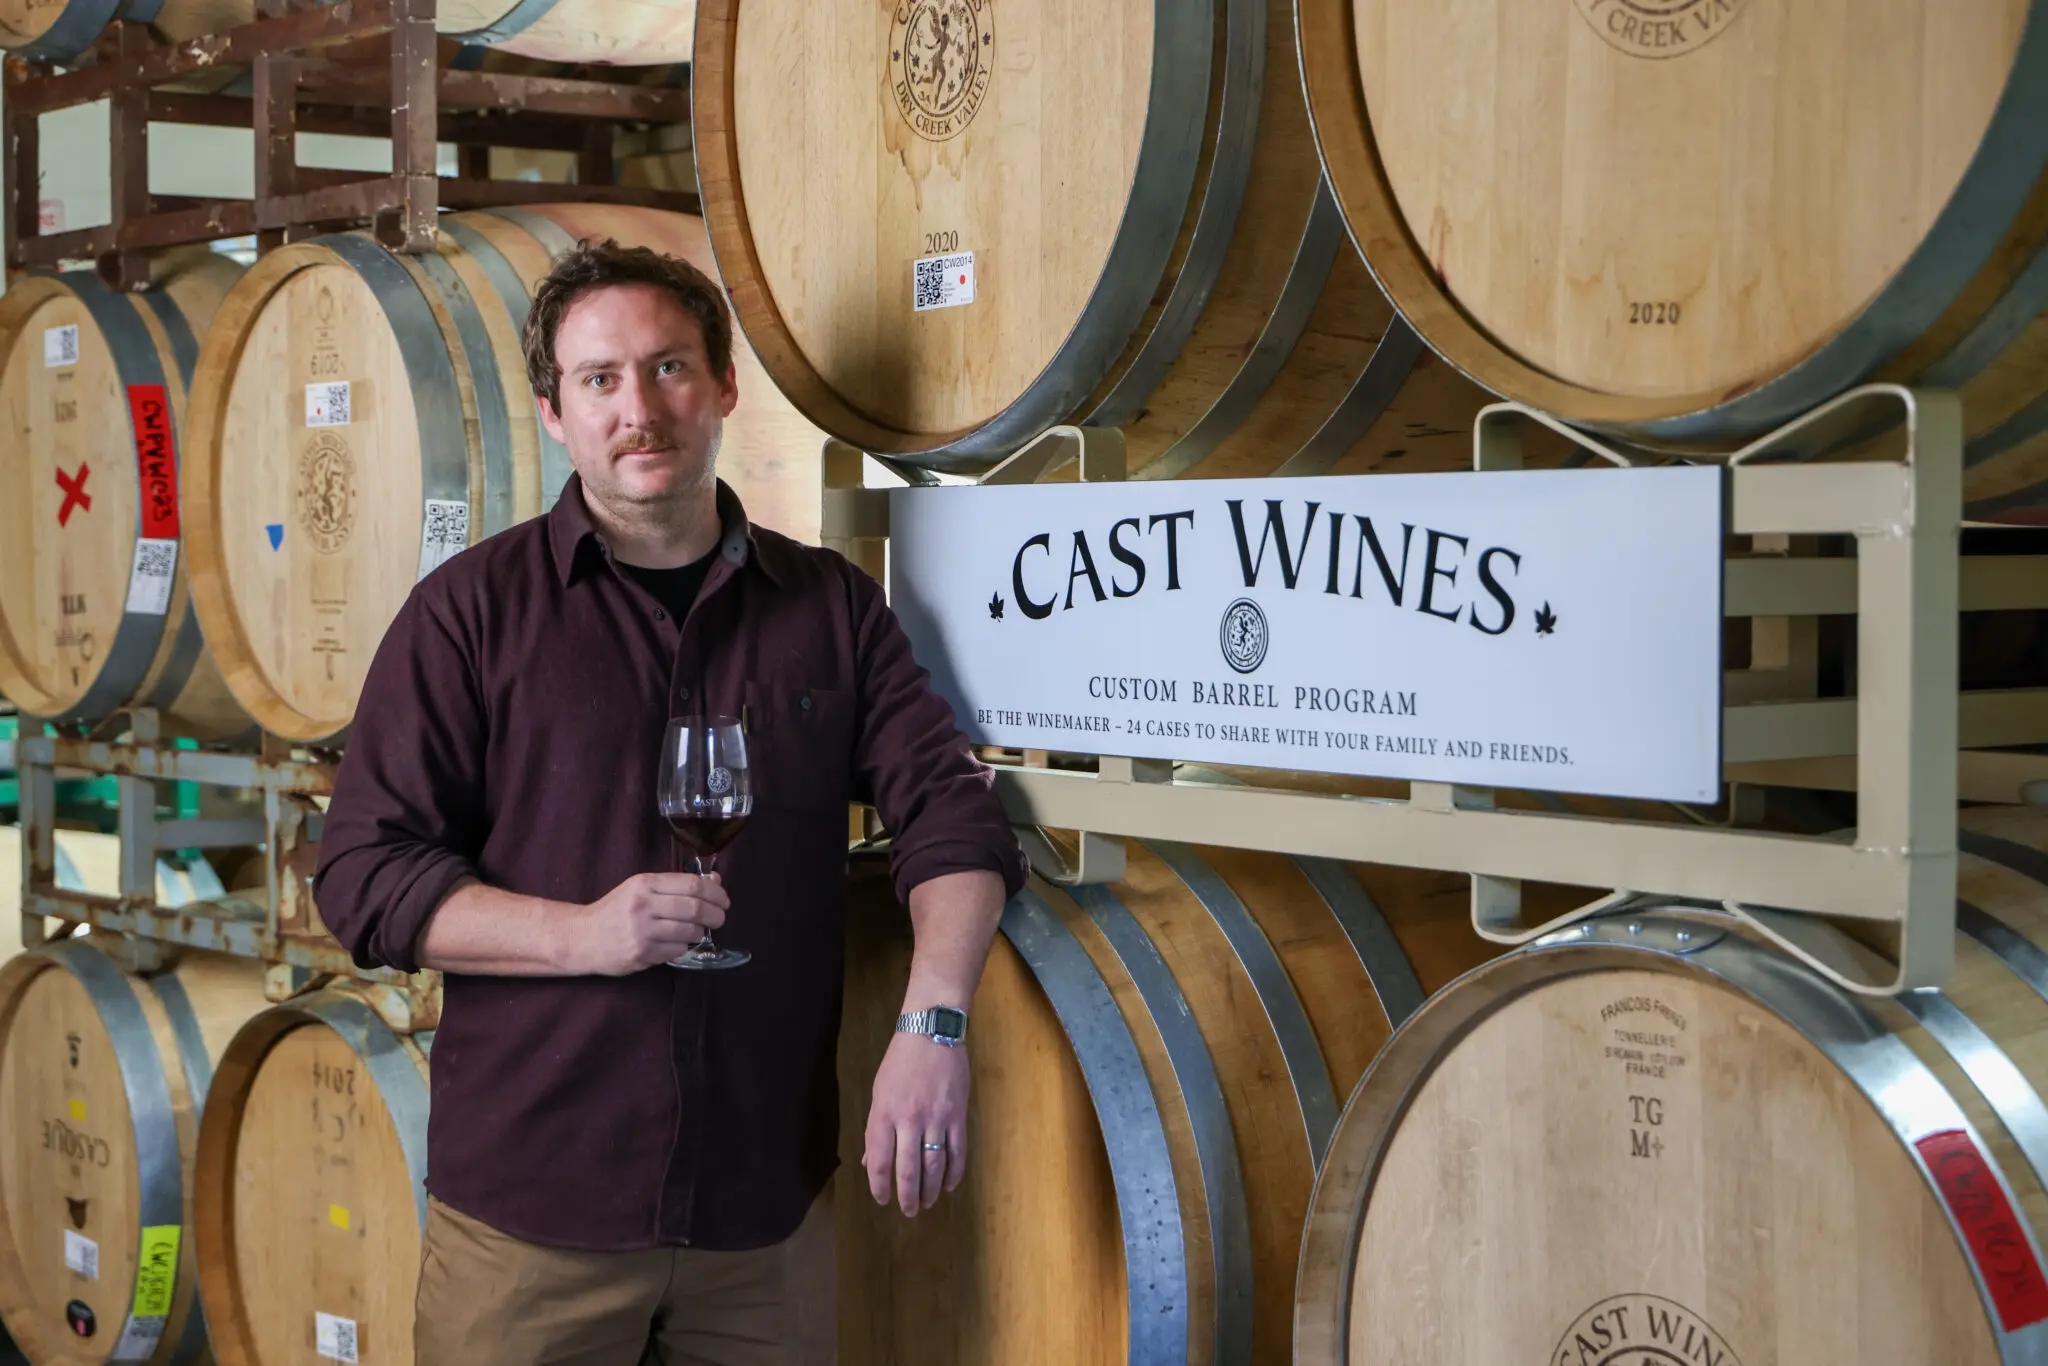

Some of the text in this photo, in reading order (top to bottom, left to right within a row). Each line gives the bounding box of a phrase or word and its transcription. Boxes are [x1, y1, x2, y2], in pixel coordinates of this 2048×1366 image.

[1607, 0, 1737, 48] CREEK VA
[896, 64, 988, 136] DRY CREEK VALLEY
[924, 230, 959, 254] 2020
[944, 255, 972, 270] CW2014
[1628, 302, 1681, 325] 2020
[1012, 498, 1522, 636] CAST WINES
[1088, 675, 1418, 716] CUSTOM BARREL PROGRAM
[977, 708, 993, 724] BE
[996, 710, 1023, 726] THE
[1026, 711, 1111, 733] WINEMAKER
[1126, 719, 1142, 734] 24
[1146, 719, 1191, 738] CASES
[1195, 722, 1216, 740] TO
[1220, 724, 1270, 744] SHARE
[1276, 728, 1319, 747] WITH
[1324, 731, 1370, 751] YOUR
[1375, 734, 1438, 755] FAMILY
[1444, 739, 1483, 758] AND
[1488, 742, 1575, 766] FRIENDS.
[1625, 1061, 1666, 1079] FRANCE
[1628, 1094, 1664, 1126] TG
[1647, 1304, 1737, 1366] WIN
